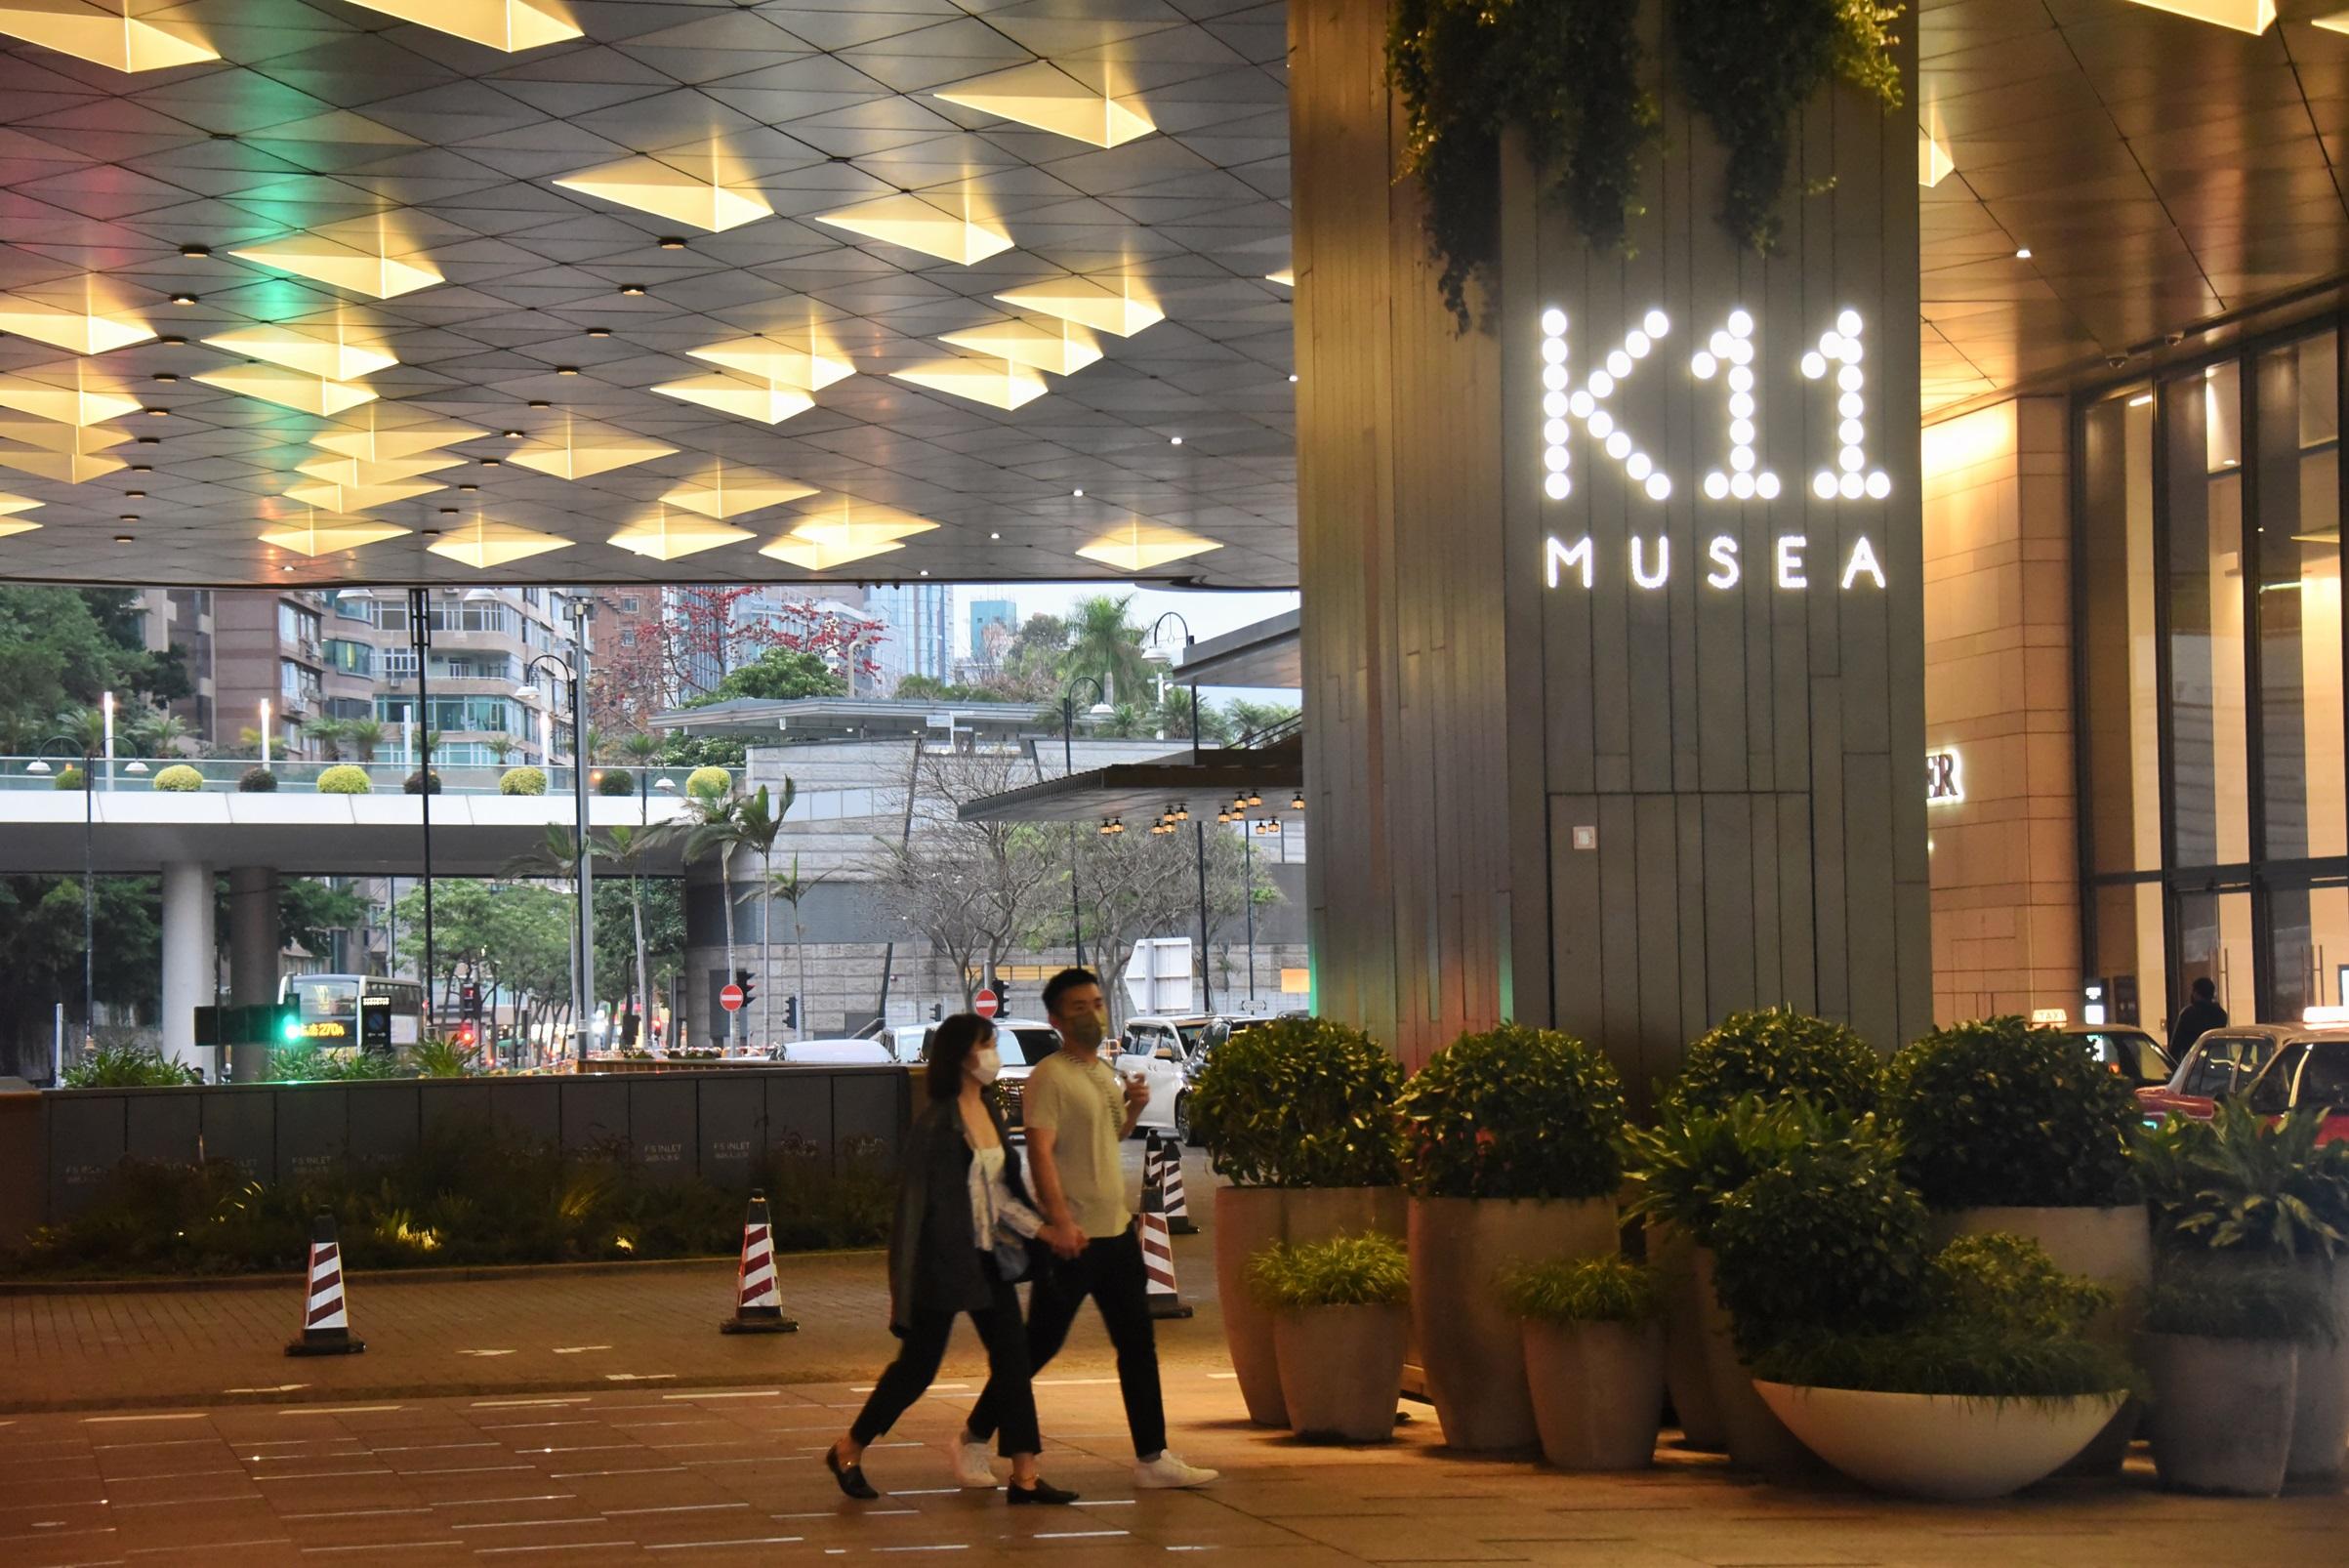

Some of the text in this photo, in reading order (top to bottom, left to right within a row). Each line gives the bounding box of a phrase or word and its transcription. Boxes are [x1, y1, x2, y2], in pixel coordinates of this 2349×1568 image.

[1542, 309, 1890, 499] K11
[1546, 536, 1885, 588] MUSEA
[2039, 1011, 2064, 1020] TAXI
[319, 1022, 344, 1036] 270A
[658, 1142, 681, 1152] INLET
[726, 1140, 750, 1150] INLET
